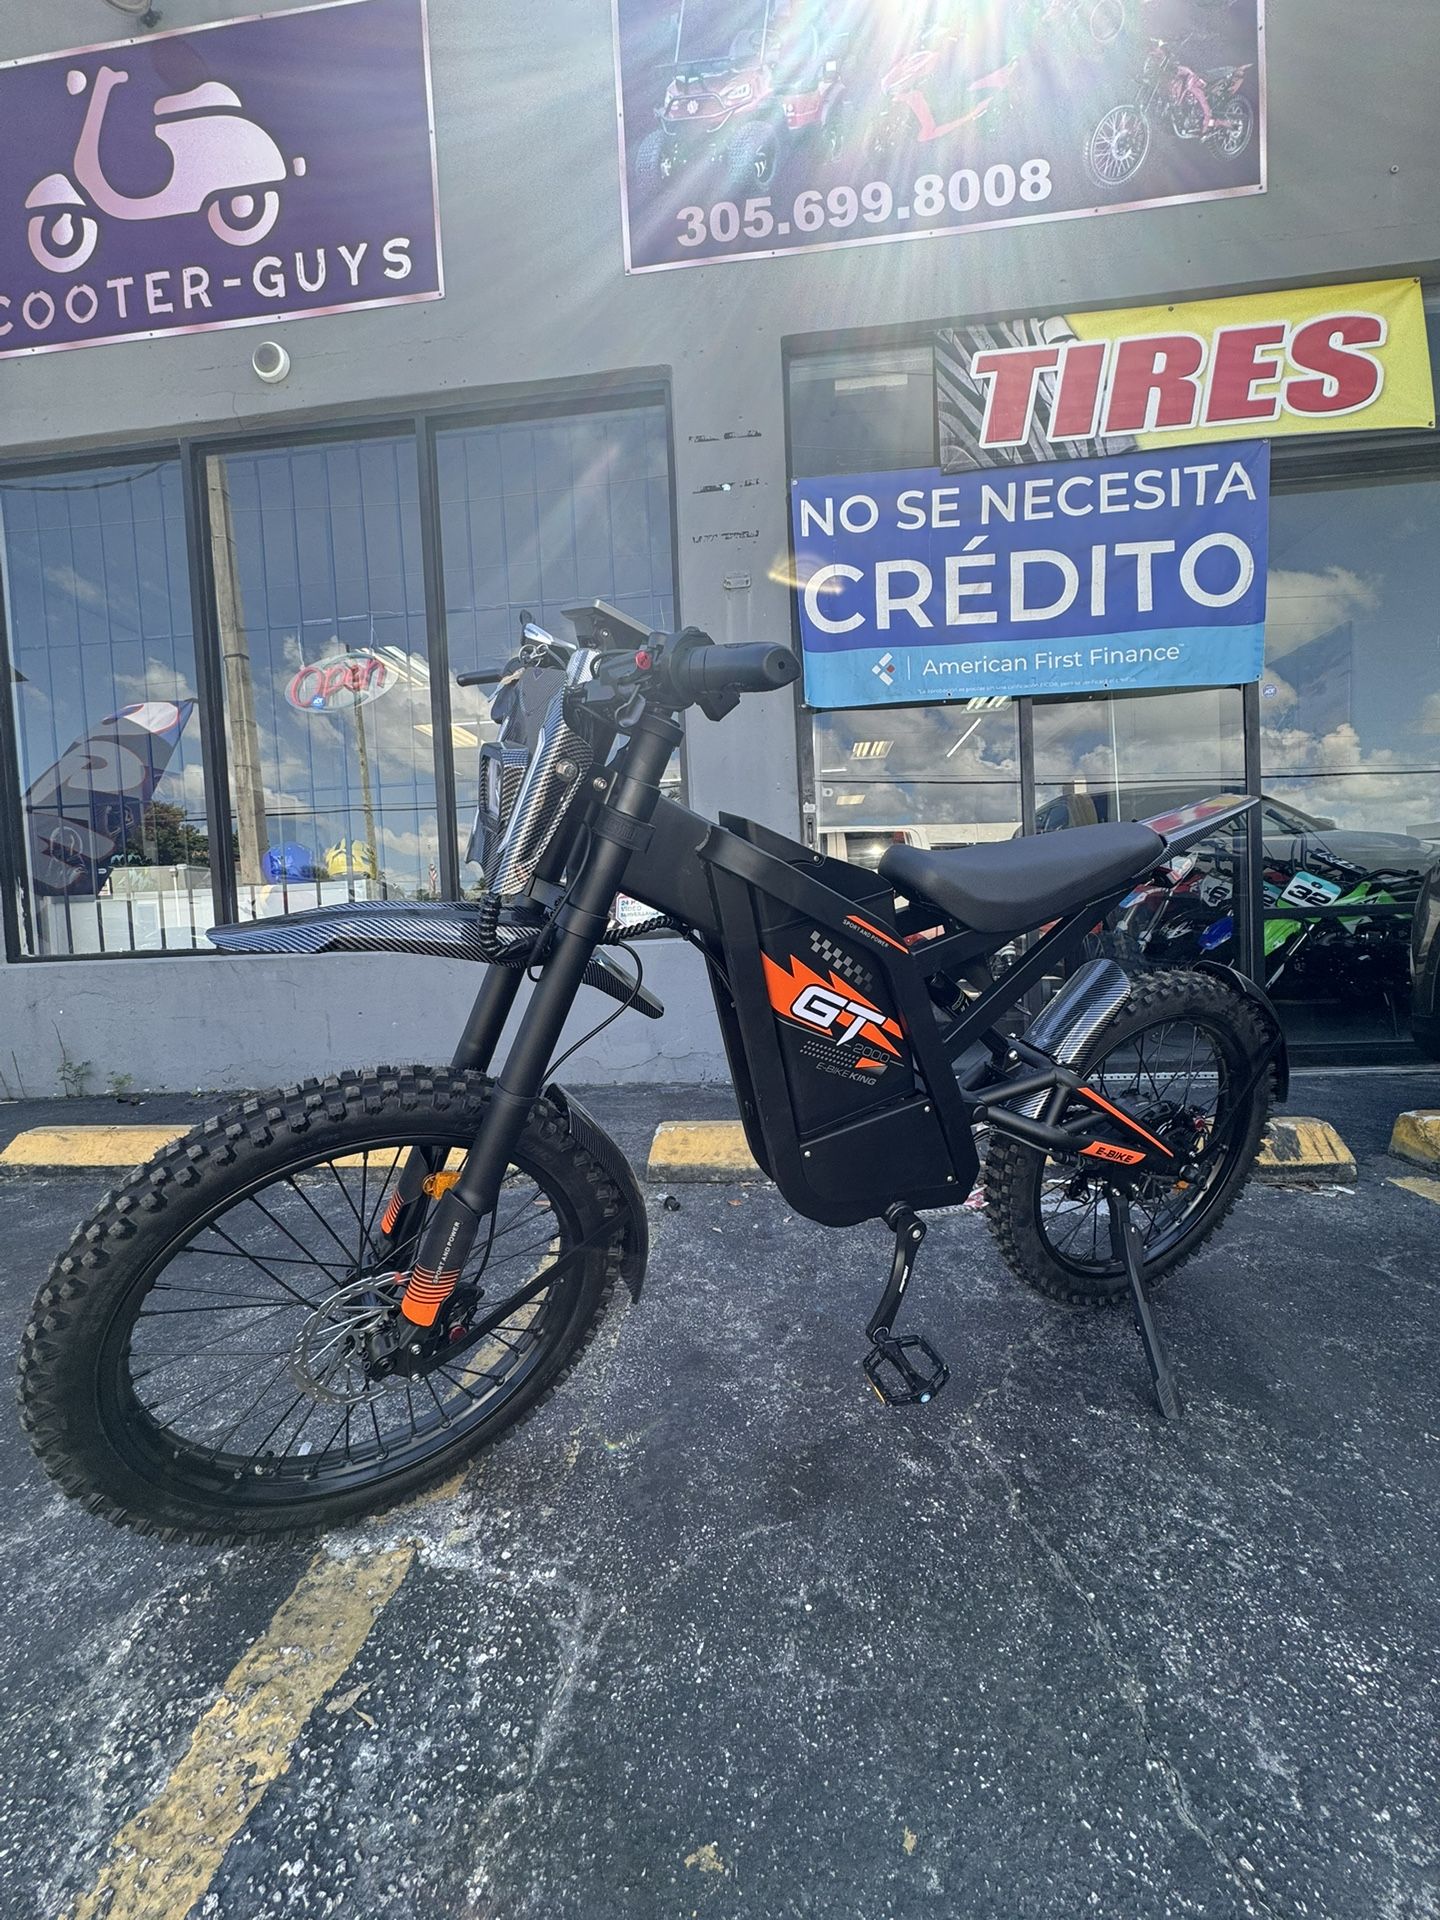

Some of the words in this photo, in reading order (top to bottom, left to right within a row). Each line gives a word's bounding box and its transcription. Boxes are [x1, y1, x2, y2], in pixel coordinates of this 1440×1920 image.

[676, 158, 1052, 247] 305.699.8008
[972, 311, 1386, 447] TIRES
[800, 495, 879, 537] NO
[897, 487, 960, 530] SE
[980, 461, 1257, 525] NECESITA
[803, 531, 1256, 634] CRÉDITO
[290, 658, 386, 709] Open
[922, 655, 1027, 677] American
[1035, 651, 1083, 670] First
[1287, 884, 1332, 907] 32
[842, 919, 860, 931] SPORT
[791, 985, 887, 1046] GT
[853, 1043, 890, 1063] 2000
[1095, 1146, 1134, 1163] E-BIKE
[441, 1247, 451, 1261] AND
[447, 1221, 460, 1247] POWER
